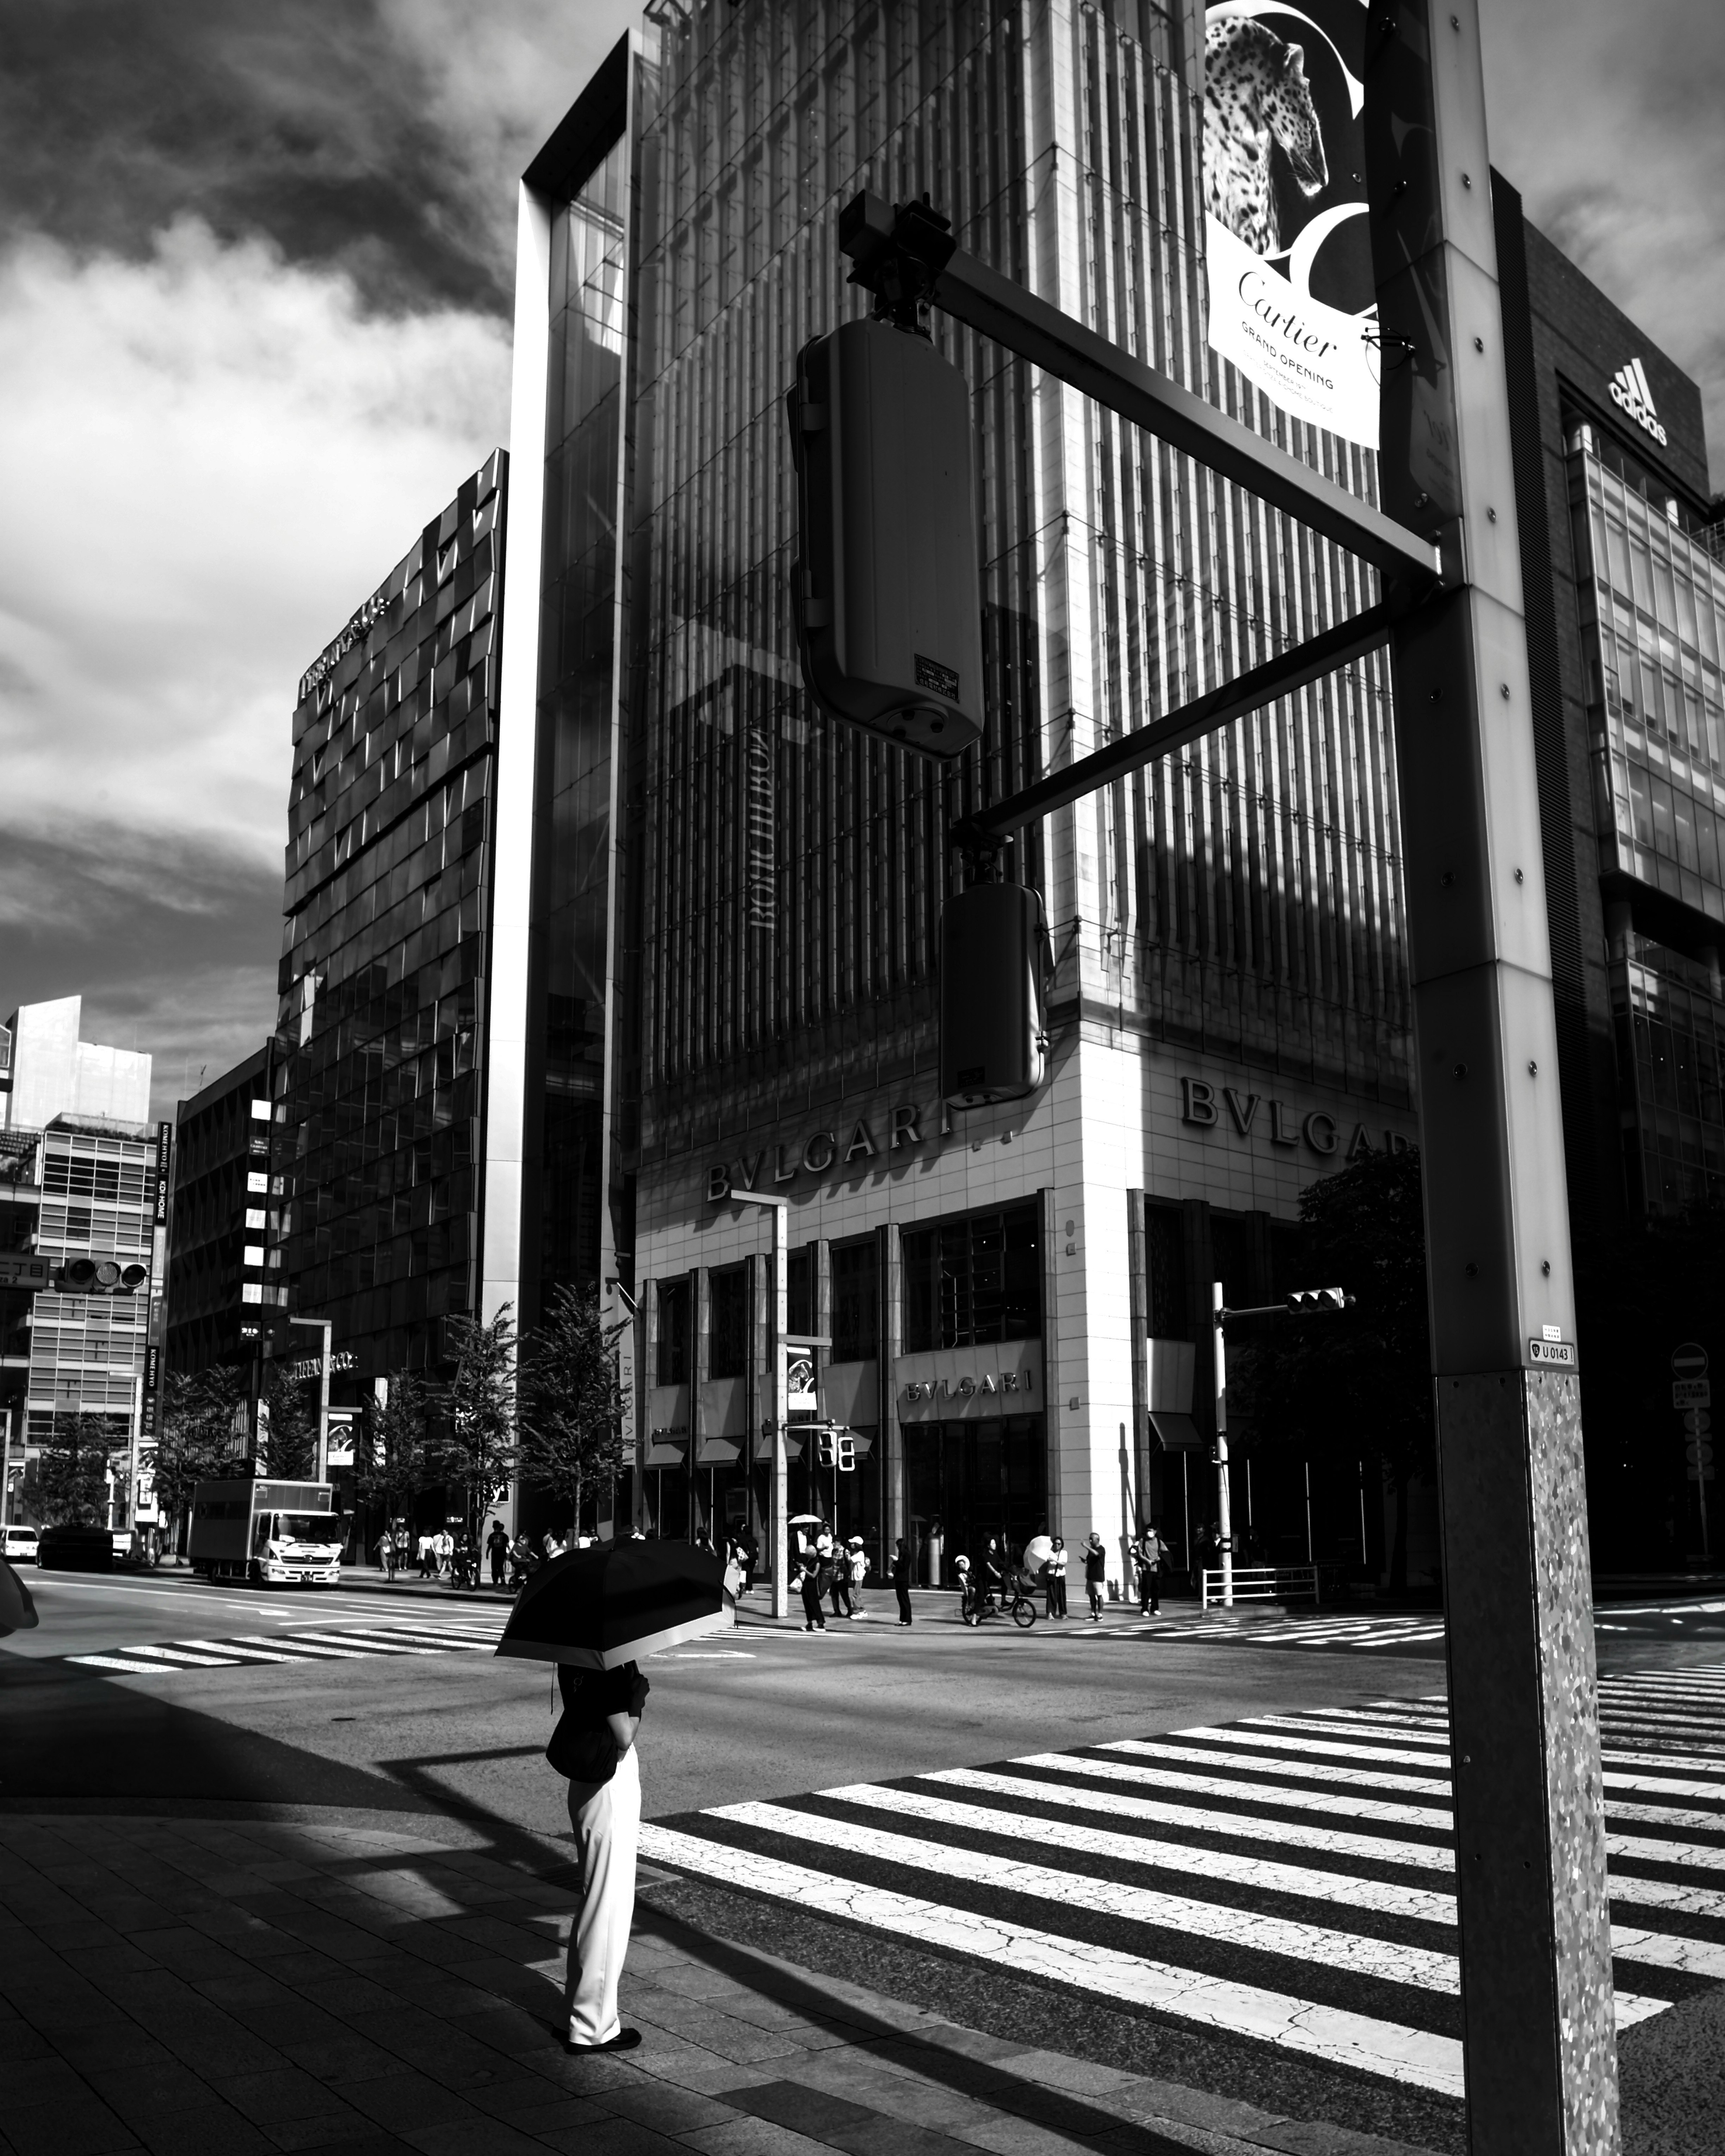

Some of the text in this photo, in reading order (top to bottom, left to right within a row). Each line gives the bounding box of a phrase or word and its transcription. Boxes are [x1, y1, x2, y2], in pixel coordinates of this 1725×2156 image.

[1239, 271, 1337, 357] Cartier
[1242, 321, 1276, 357] GRAND
[1280, 354, 1333, 389] OPENING
[1608, 381, 1667, 447] adidas
[706, 1097, 952, 1203] BVLGARI
[1182, 1076, 1413, 1161] BVLGAR
[293, 1357, 322, 1380] TIFFAN
[905, 1370, 1032, 1401] BVLGARI
[1551, 1347, 1568, 1360] 0143
[624, 1357, 633, 1449] VLGARI
